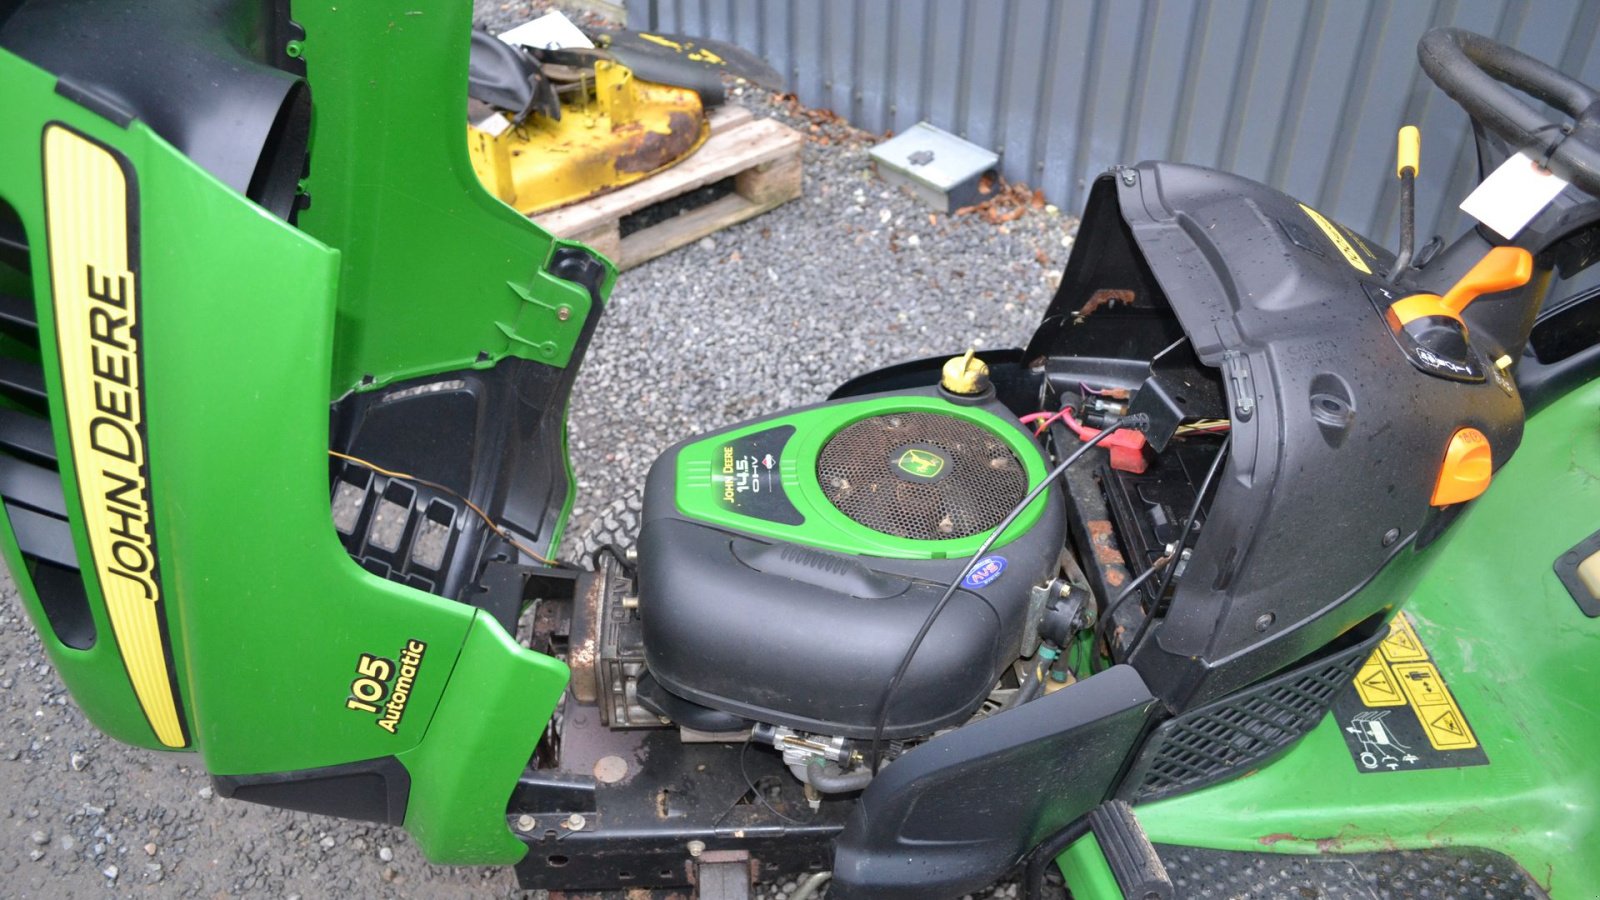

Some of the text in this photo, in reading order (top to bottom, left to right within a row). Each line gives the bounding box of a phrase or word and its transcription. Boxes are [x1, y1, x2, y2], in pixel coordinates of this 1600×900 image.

[86, 263, 154, 601] JOHN DEERE
[722, 446, 735, 503] JOHN DEERE
[751, 455, 760, 493] OHV
[346, 654, 392, 714] 105
[377, 640, 426, 734] Automatic
